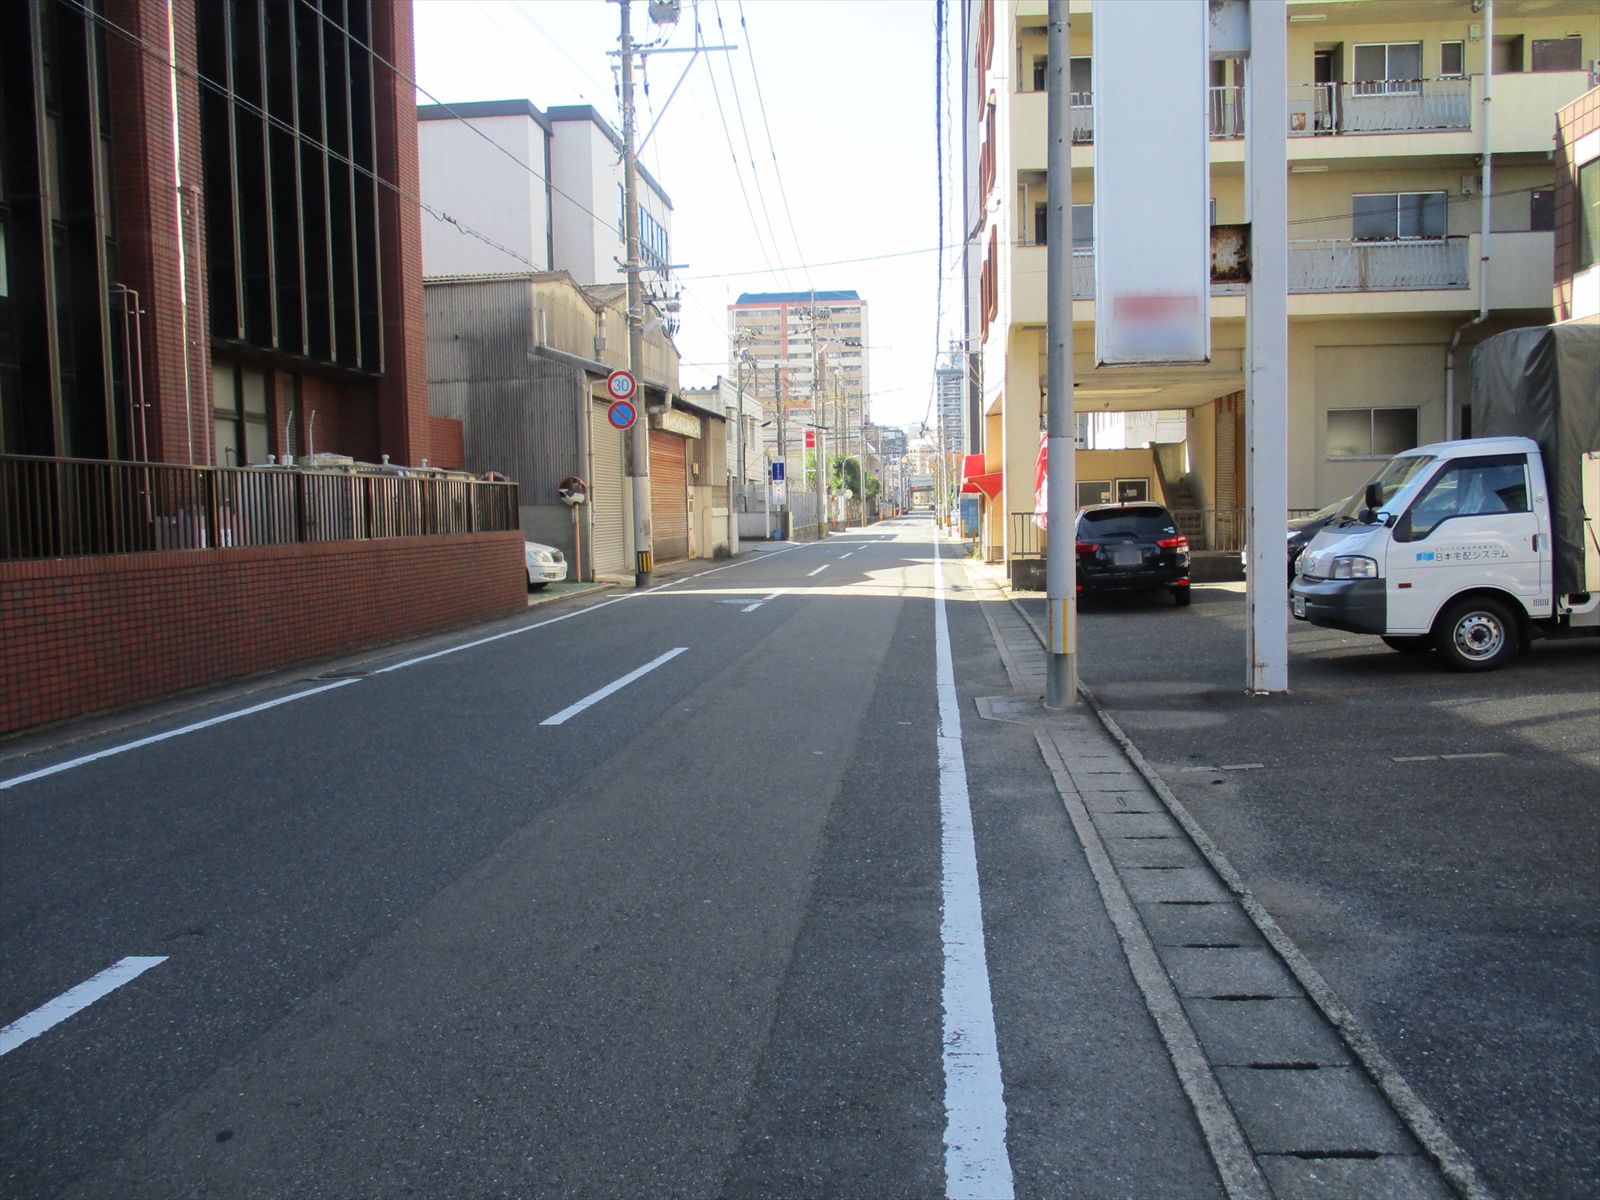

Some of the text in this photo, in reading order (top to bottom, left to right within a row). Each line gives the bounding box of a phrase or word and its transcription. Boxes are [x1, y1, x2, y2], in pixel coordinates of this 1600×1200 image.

[613, 378, 630, 392] 30
[1435, 550, 1509, 562] 日本宅配システム
